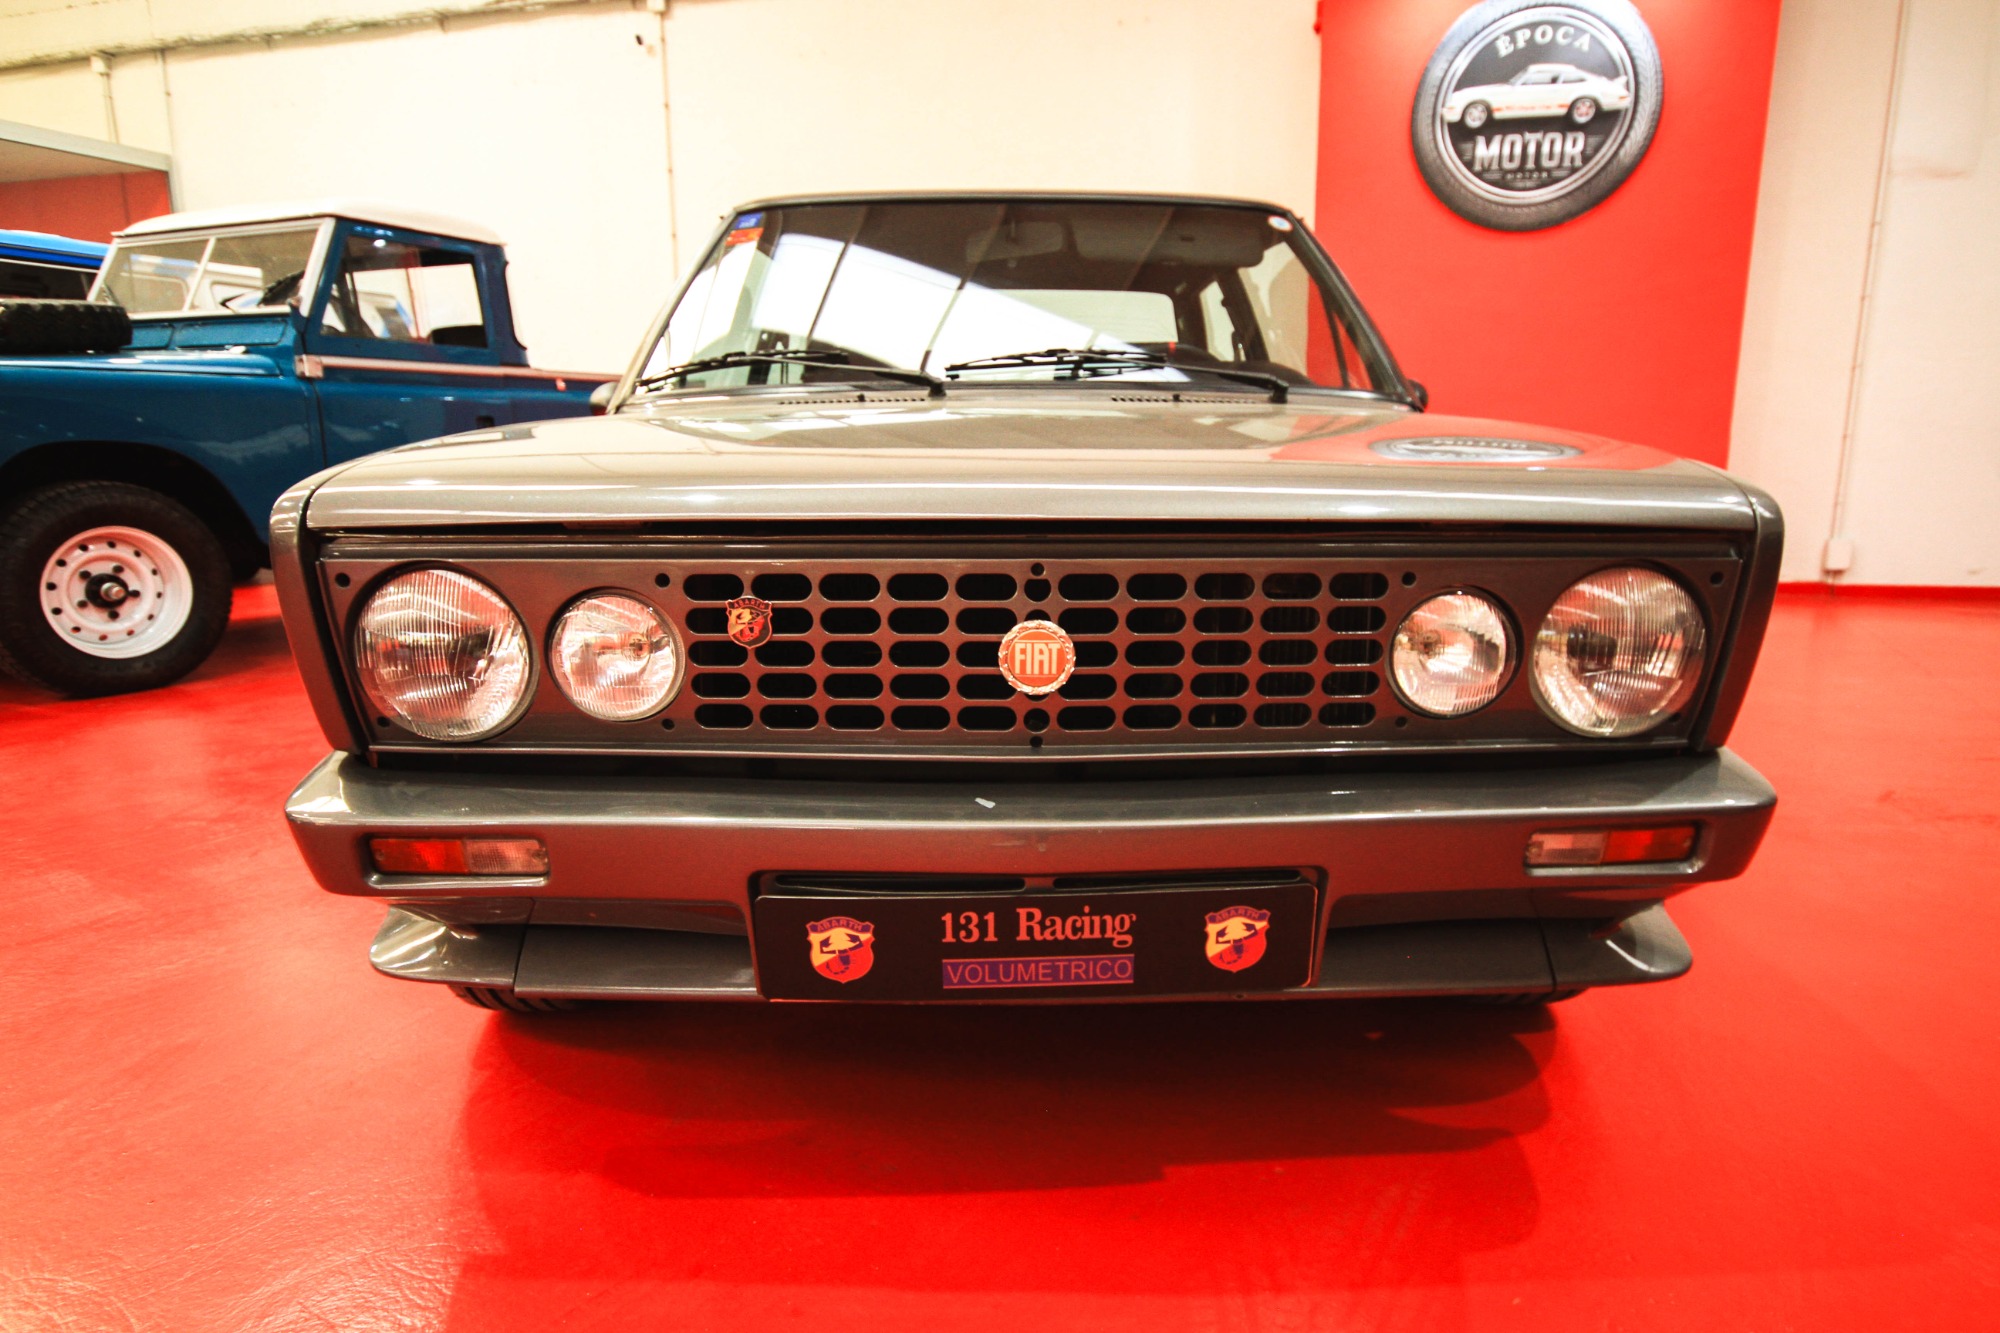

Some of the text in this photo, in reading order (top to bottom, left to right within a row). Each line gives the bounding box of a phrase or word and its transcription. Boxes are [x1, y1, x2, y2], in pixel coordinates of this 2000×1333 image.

[1473, 131, 1585, 171] MOTOR
[734, 599, 766, 609] ABARTH
[1014, 642, 1061, 675] FIAT
[817, 919, 862, 932] ABARTH
[941, 905, 1136, 948] 131 Racing
[1215, 908, 1259, 922] ABARTH
[947, 958, 1132, 984] VOLUMETRICO
